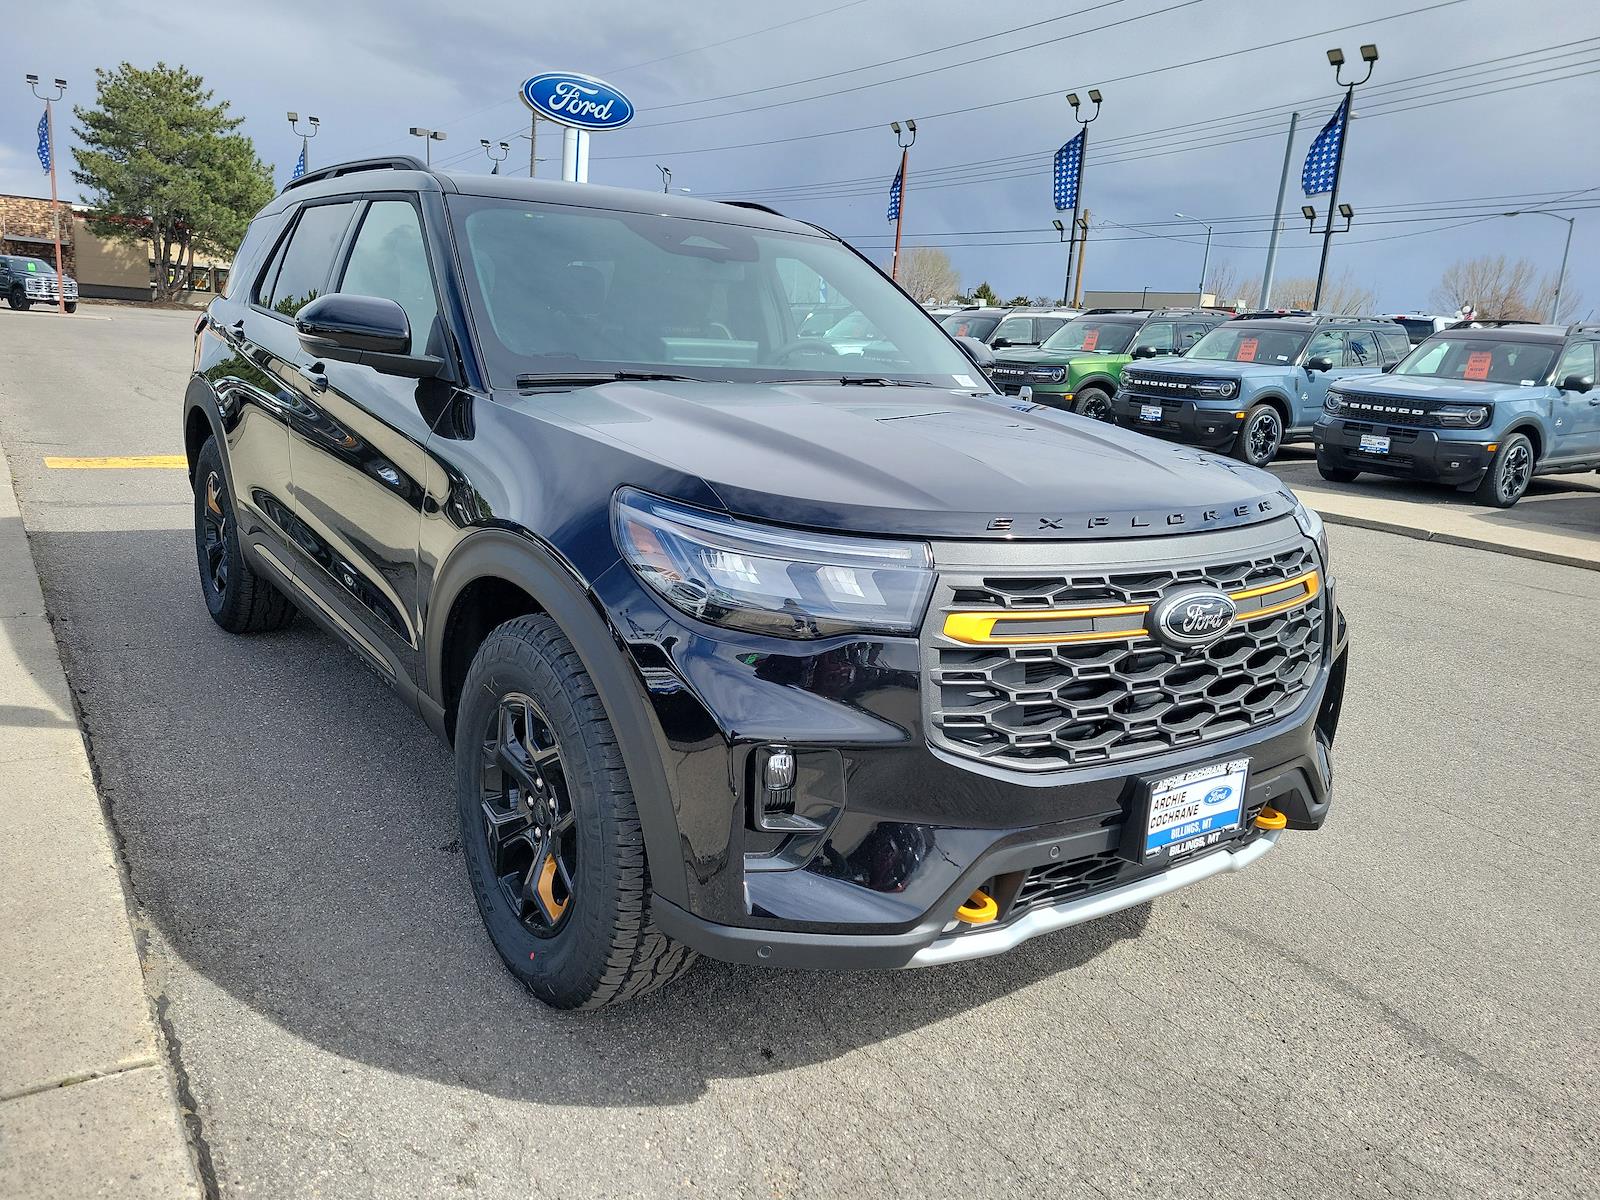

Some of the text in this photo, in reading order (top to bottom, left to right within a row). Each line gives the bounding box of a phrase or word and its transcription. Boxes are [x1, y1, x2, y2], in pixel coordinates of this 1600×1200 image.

[549, 82, 614, 120] Ford
[1133, 380, 1187, 389] BRONCO
[1349, 402, 1424, 416] BRONCO
[986, 500, 1273, 531] EXPLORER
[1182, 603, 1224, 632] Ford
[1153, 791, 1187, 811] ARCHIE
[1208, 787, 1228, 803] Ford
[1150, 804, 1199, 829] COCHRANE
[1171, 817, 1213, 840] BILLINGS, MT
[1169, 832, 1221, 856] BILLINGS, MT
